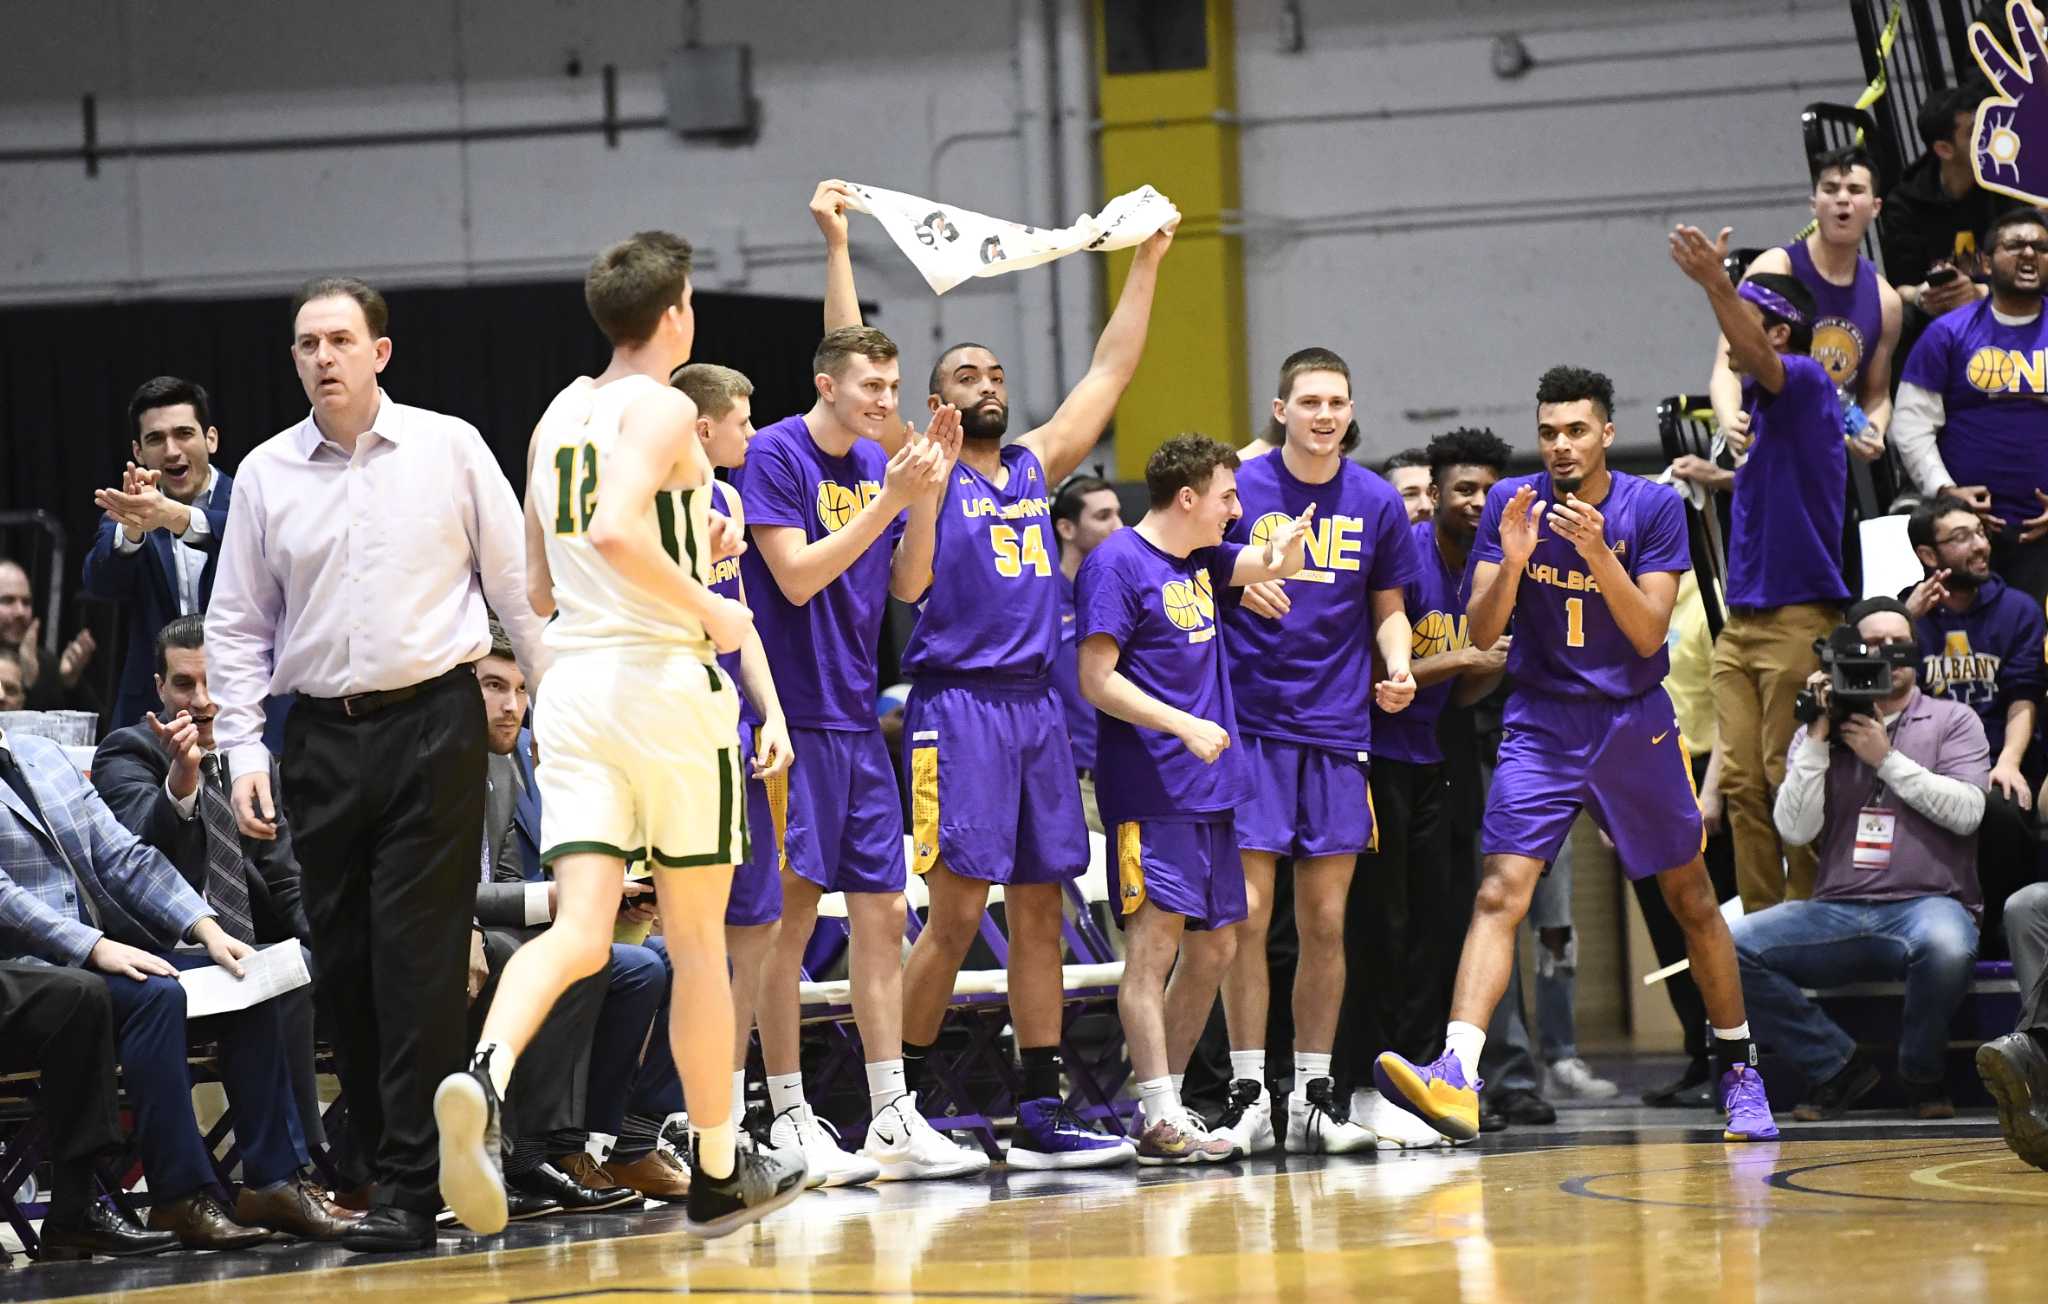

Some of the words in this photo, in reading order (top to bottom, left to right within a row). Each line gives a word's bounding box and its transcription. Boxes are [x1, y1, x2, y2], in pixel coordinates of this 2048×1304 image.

[1966, 345, 2048, 394] ON
[554, 440, 600, 536] 12
[990, 524, 1052, 577] 54
[1526, 560, 1602, 593] UALBA
[1566, 597, 1585, 648] 1
